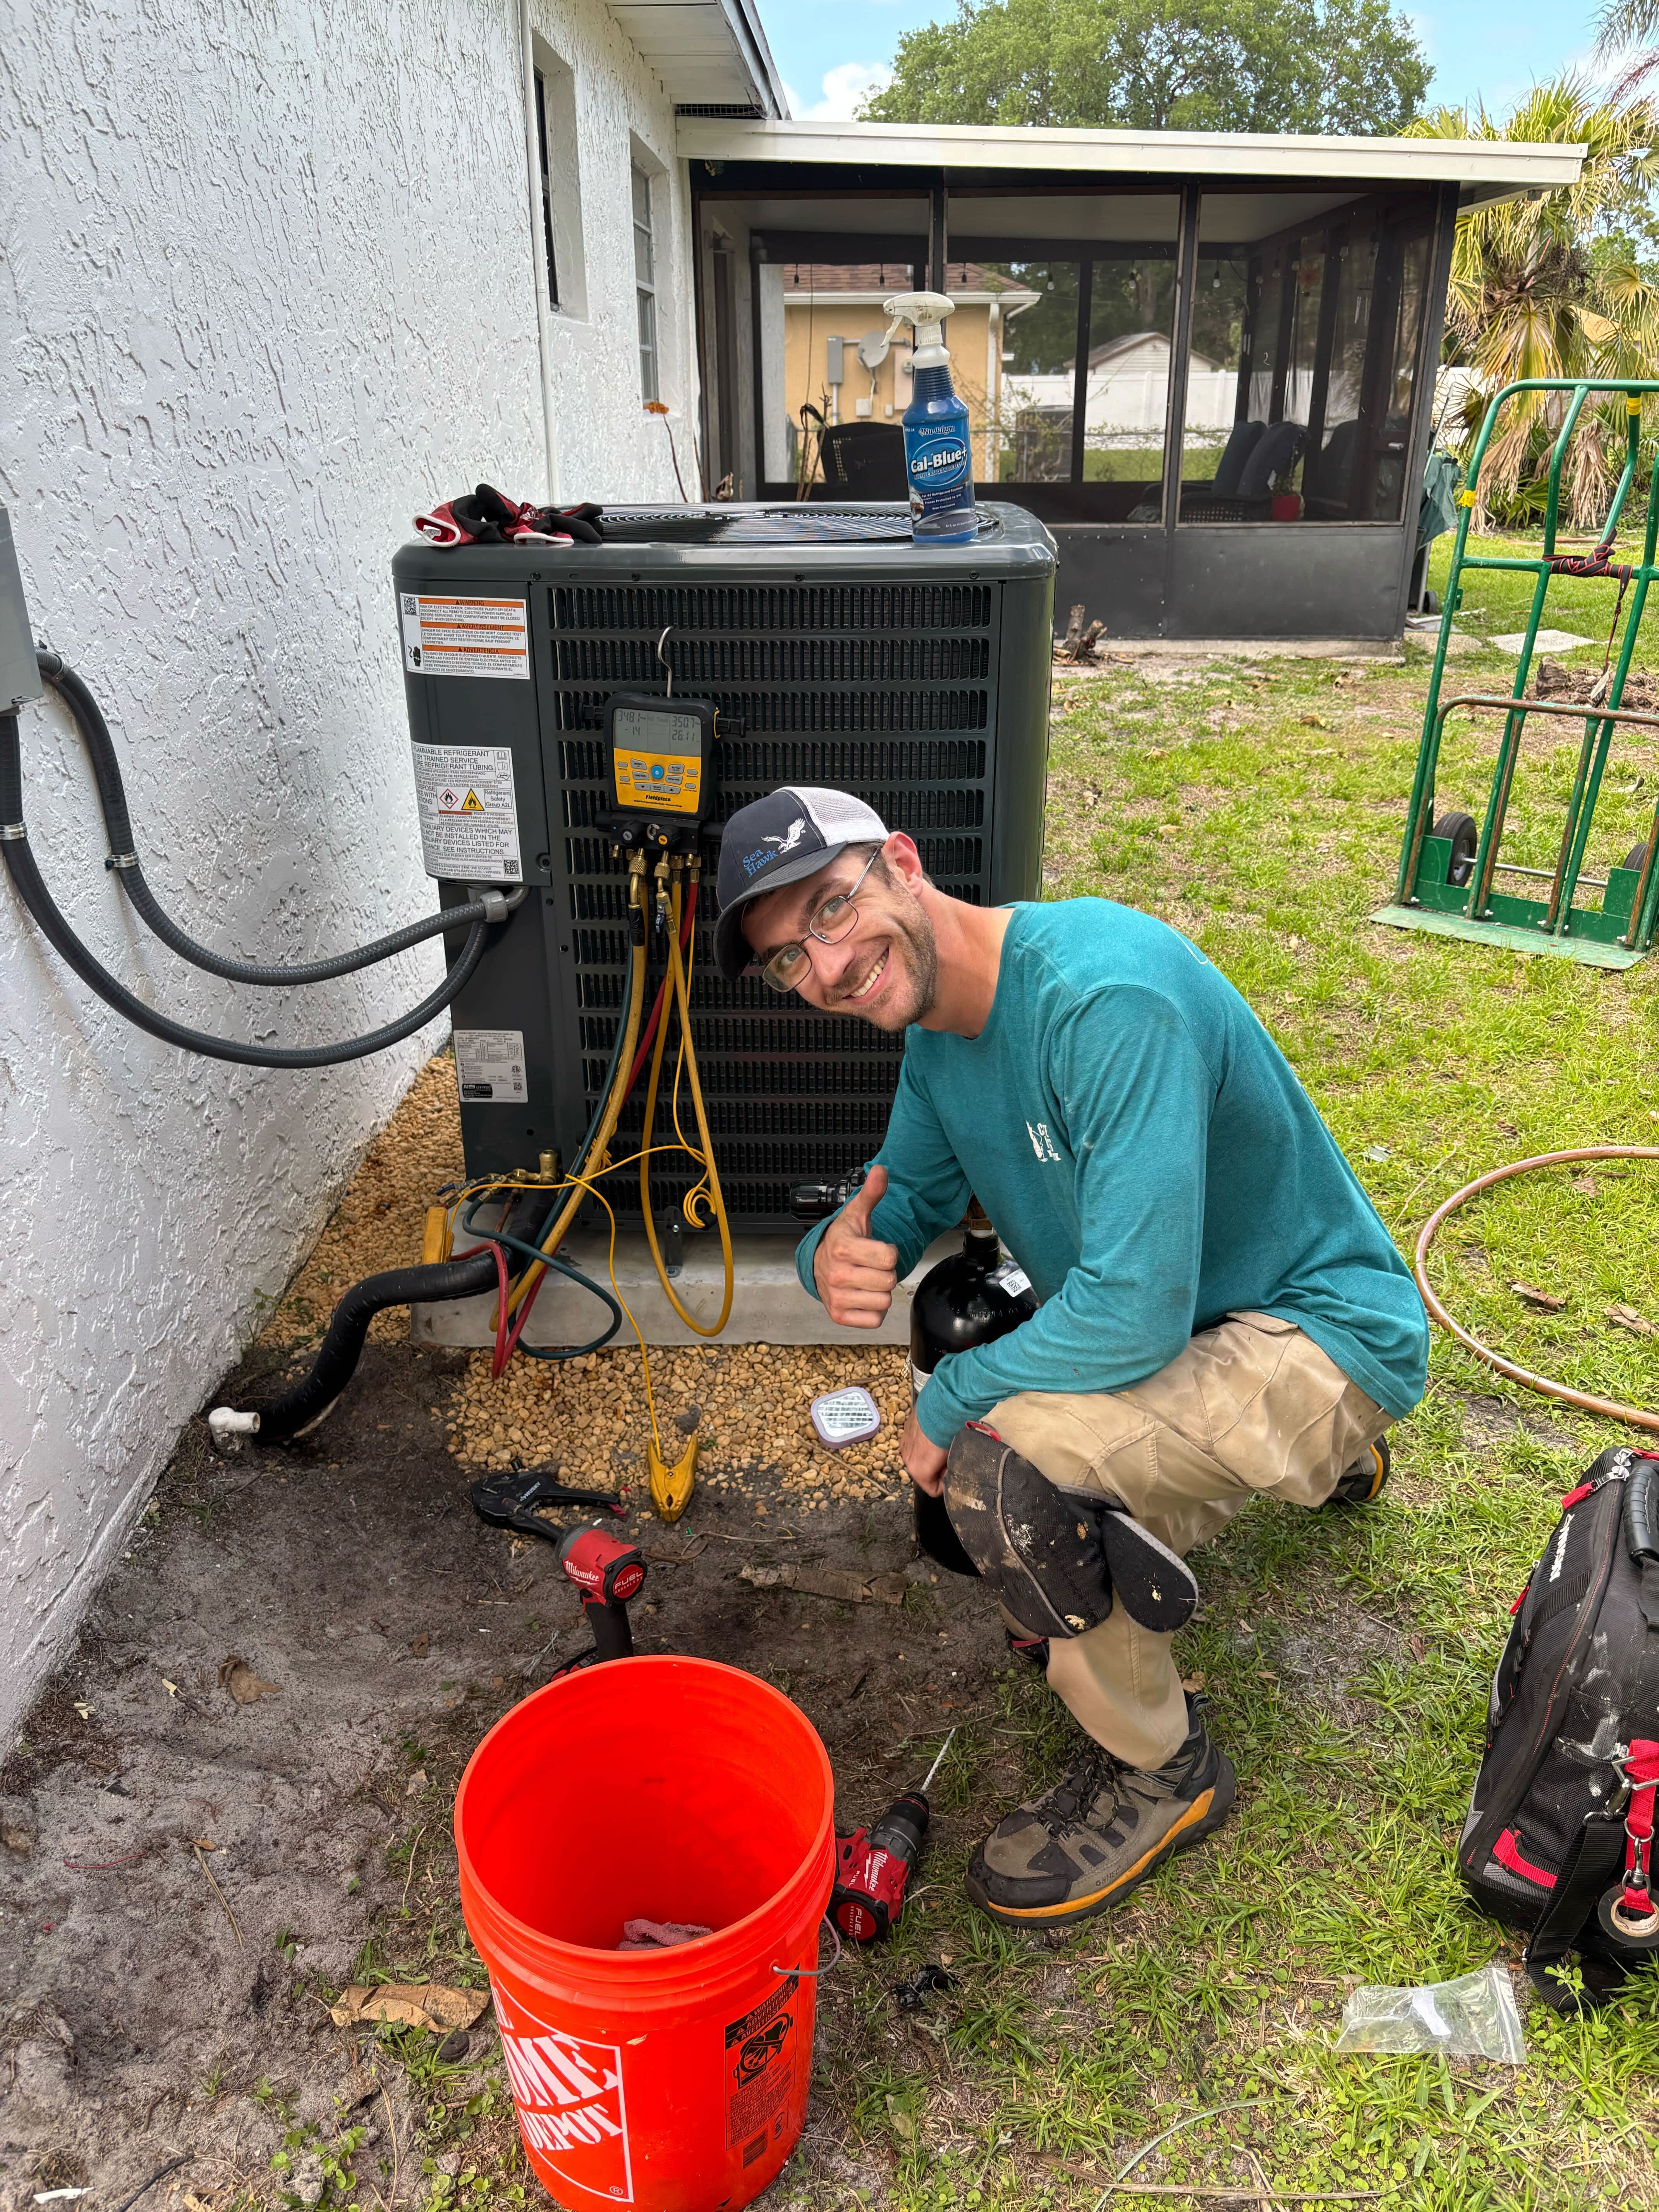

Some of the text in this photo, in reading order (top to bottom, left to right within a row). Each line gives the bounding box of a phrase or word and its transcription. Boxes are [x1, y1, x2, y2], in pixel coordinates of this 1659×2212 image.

[424, 761, 467, 769] REFRIGERANT
[743, 849, 764, 867] Sea
[745, 850, 778, 877] Hawk
[524, 1481, 541, 1497] HUSKY
[565, 1560, 599, 1581] Milwaukee
[615, 1572, 643, 1590] FUEL
[848, 1870, 860, 1887] FUEL
[869, 1851, 888, 1891] Milwaukee
[741, 1982, 796, 2040] AVERTISSEMENT
[747, 1982, 793, 2029] ADVERTENCIA
[754, 1982, 787, 2014] WARNING
[503, 2032, 619, 2107] OME
[519, 2103, 623, 2150] DEPOT
